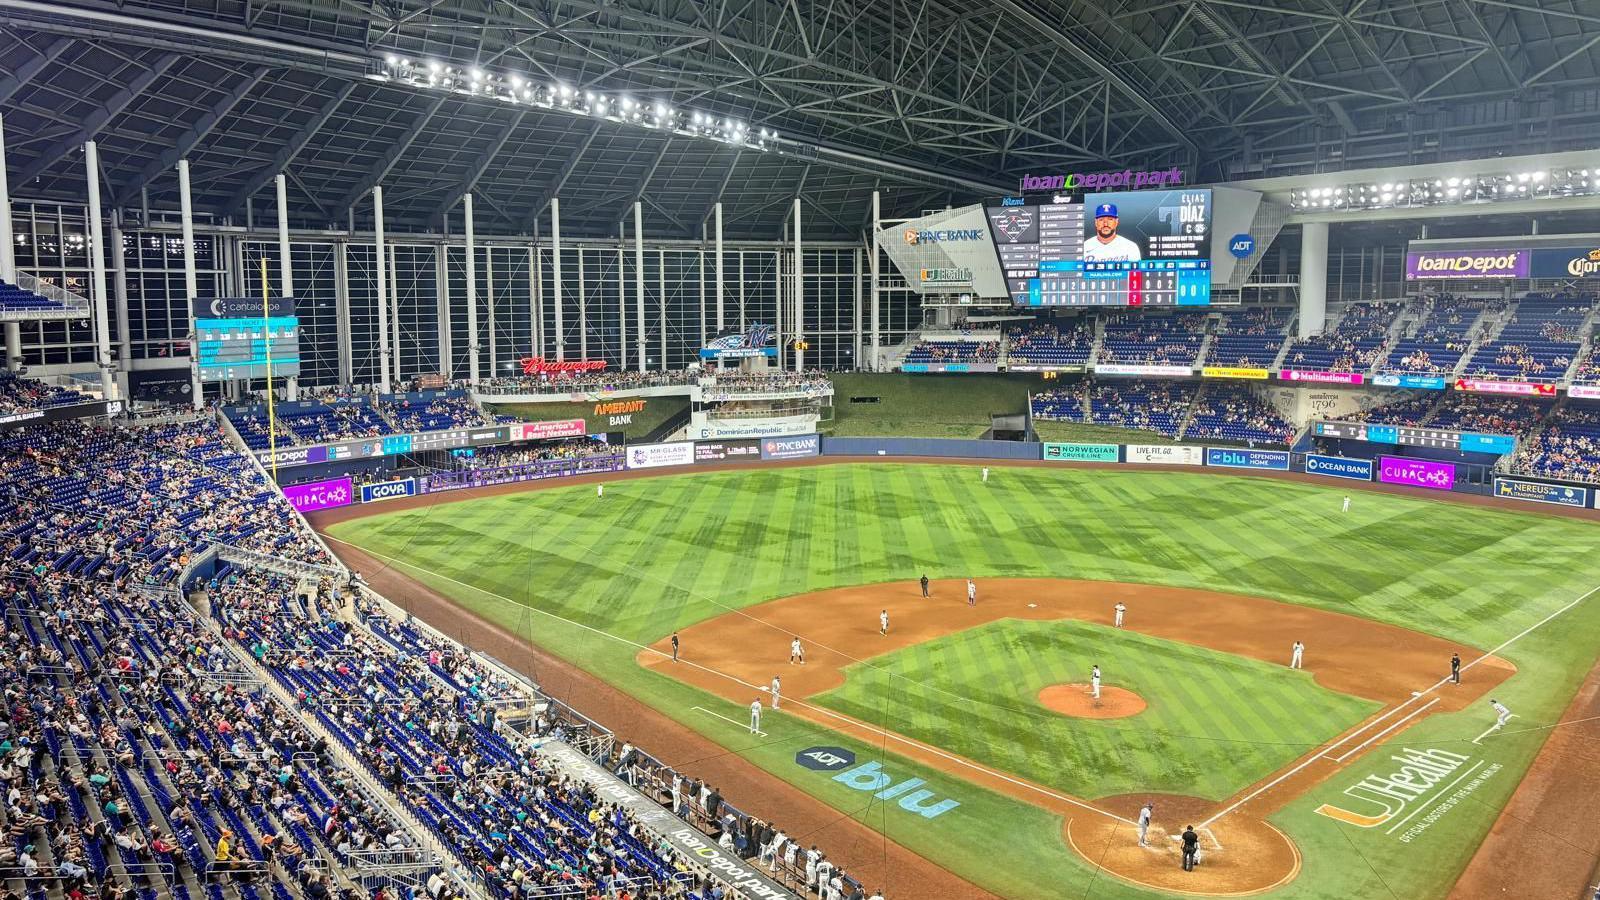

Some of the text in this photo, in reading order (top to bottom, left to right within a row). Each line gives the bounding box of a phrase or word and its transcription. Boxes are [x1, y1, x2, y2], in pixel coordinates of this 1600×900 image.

[1023, 166, 1184, 190] loanDepot park
[1231, 241, 1253, 251] ADT
[1416, 253, 1518, 273] loanDepot
[229, 303, 280, 312] cantalope
[521, 356, 608, 373] Budweiser
[1300, 371, 1351, 383] Multinational
[594, 400, 647, 415] AMERANT
[1312, 400, 1336, 411] 1796
[609, 415, 632, 426] BANK
[527, 429, 582, 439] Best Network
[533, 423, 575, 432] America's
[1062, 446, 1115, 454] NORWEGIAN
[1222, 452, 1246, 464] blu
[1250, 453, 1286, 461] DEFENDING
[1318, 461, 1369, 475] OCEAN BANK
[373, 484, 406, 498] GOYA
[1514, 483, 1549, 495] NEREUS
[804, 750, 847, 767] ADT
[832, 760, 961, 819] blu
[1313, 747, 1470, 828] UHealth
[1399, 821, 1431, 843] OFFICIAL
[1423, 802, 1453, 823] DOCTORS
[1453, 789, 1472, 800] THE
[1464, 778, 1485, 791] MIAMI
[671, 828, 789, 900] loanDepot park
